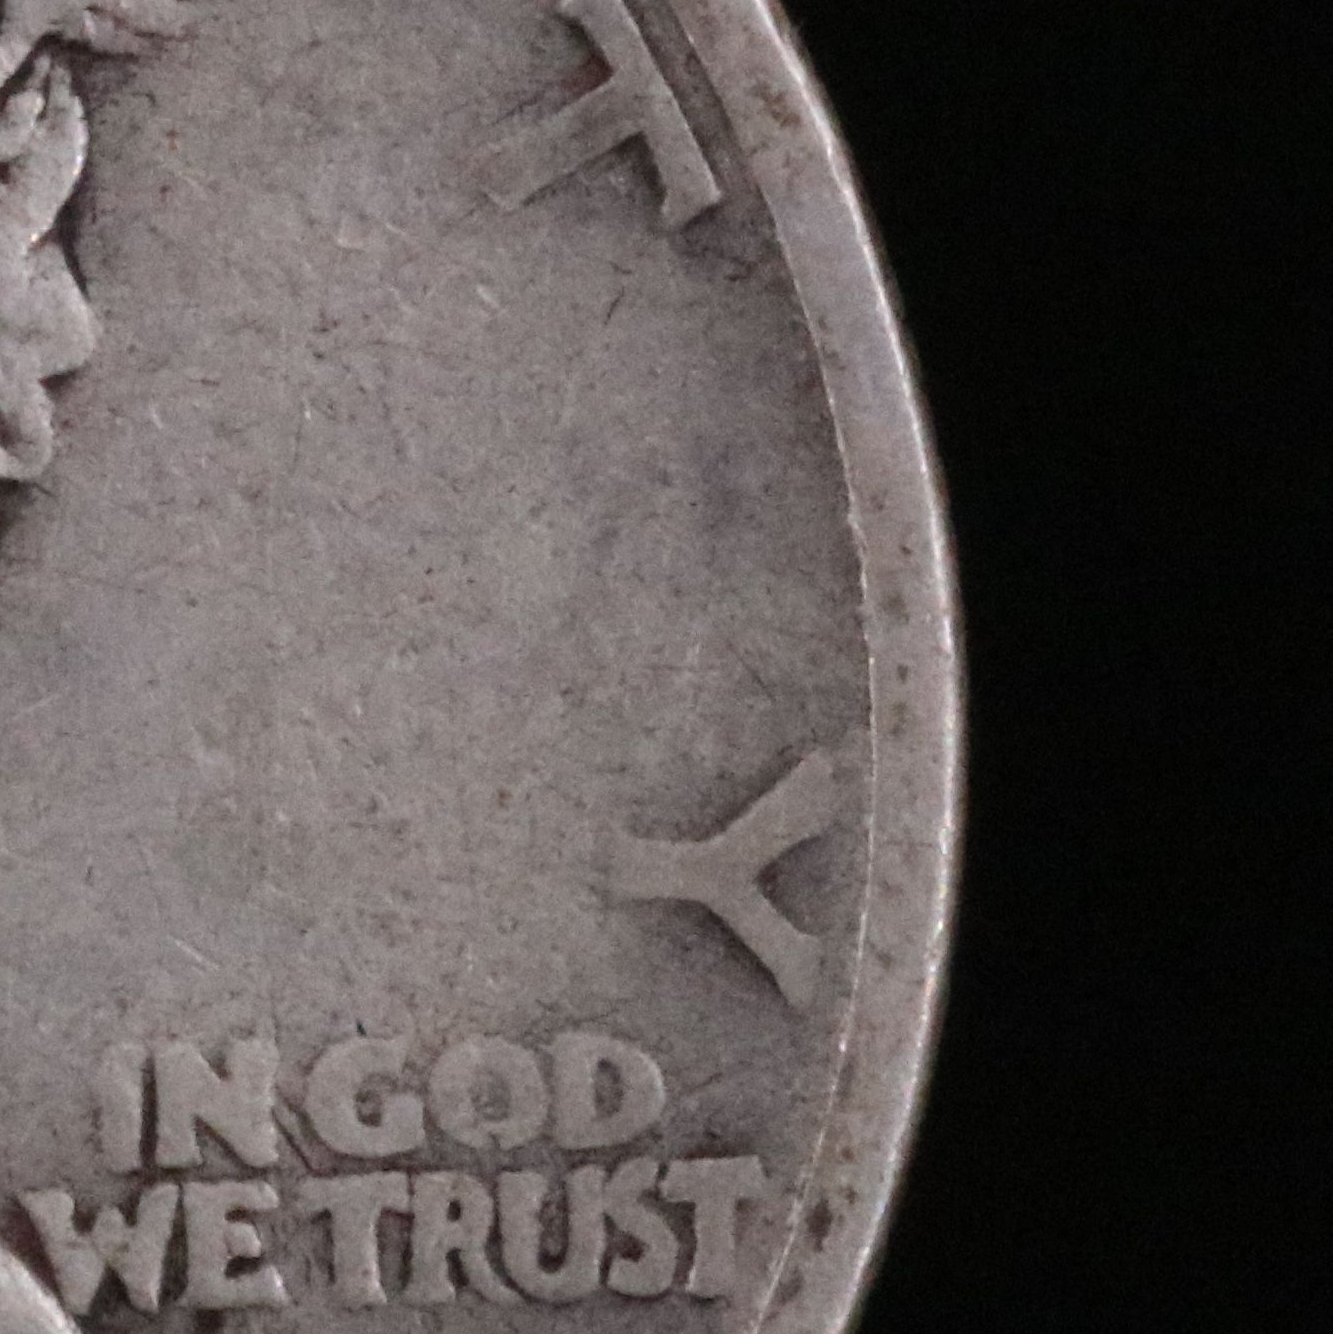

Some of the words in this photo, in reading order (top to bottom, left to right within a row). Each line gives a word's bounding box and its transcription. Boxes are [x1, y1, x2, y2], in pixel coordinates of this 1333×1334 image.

[99, 1031, 279, 1168] IN
[304, 1031, 666, 1158] GOD
[19, 1179, 286, 1314] WE
[299, 1155, 771, 1307] TRUST
